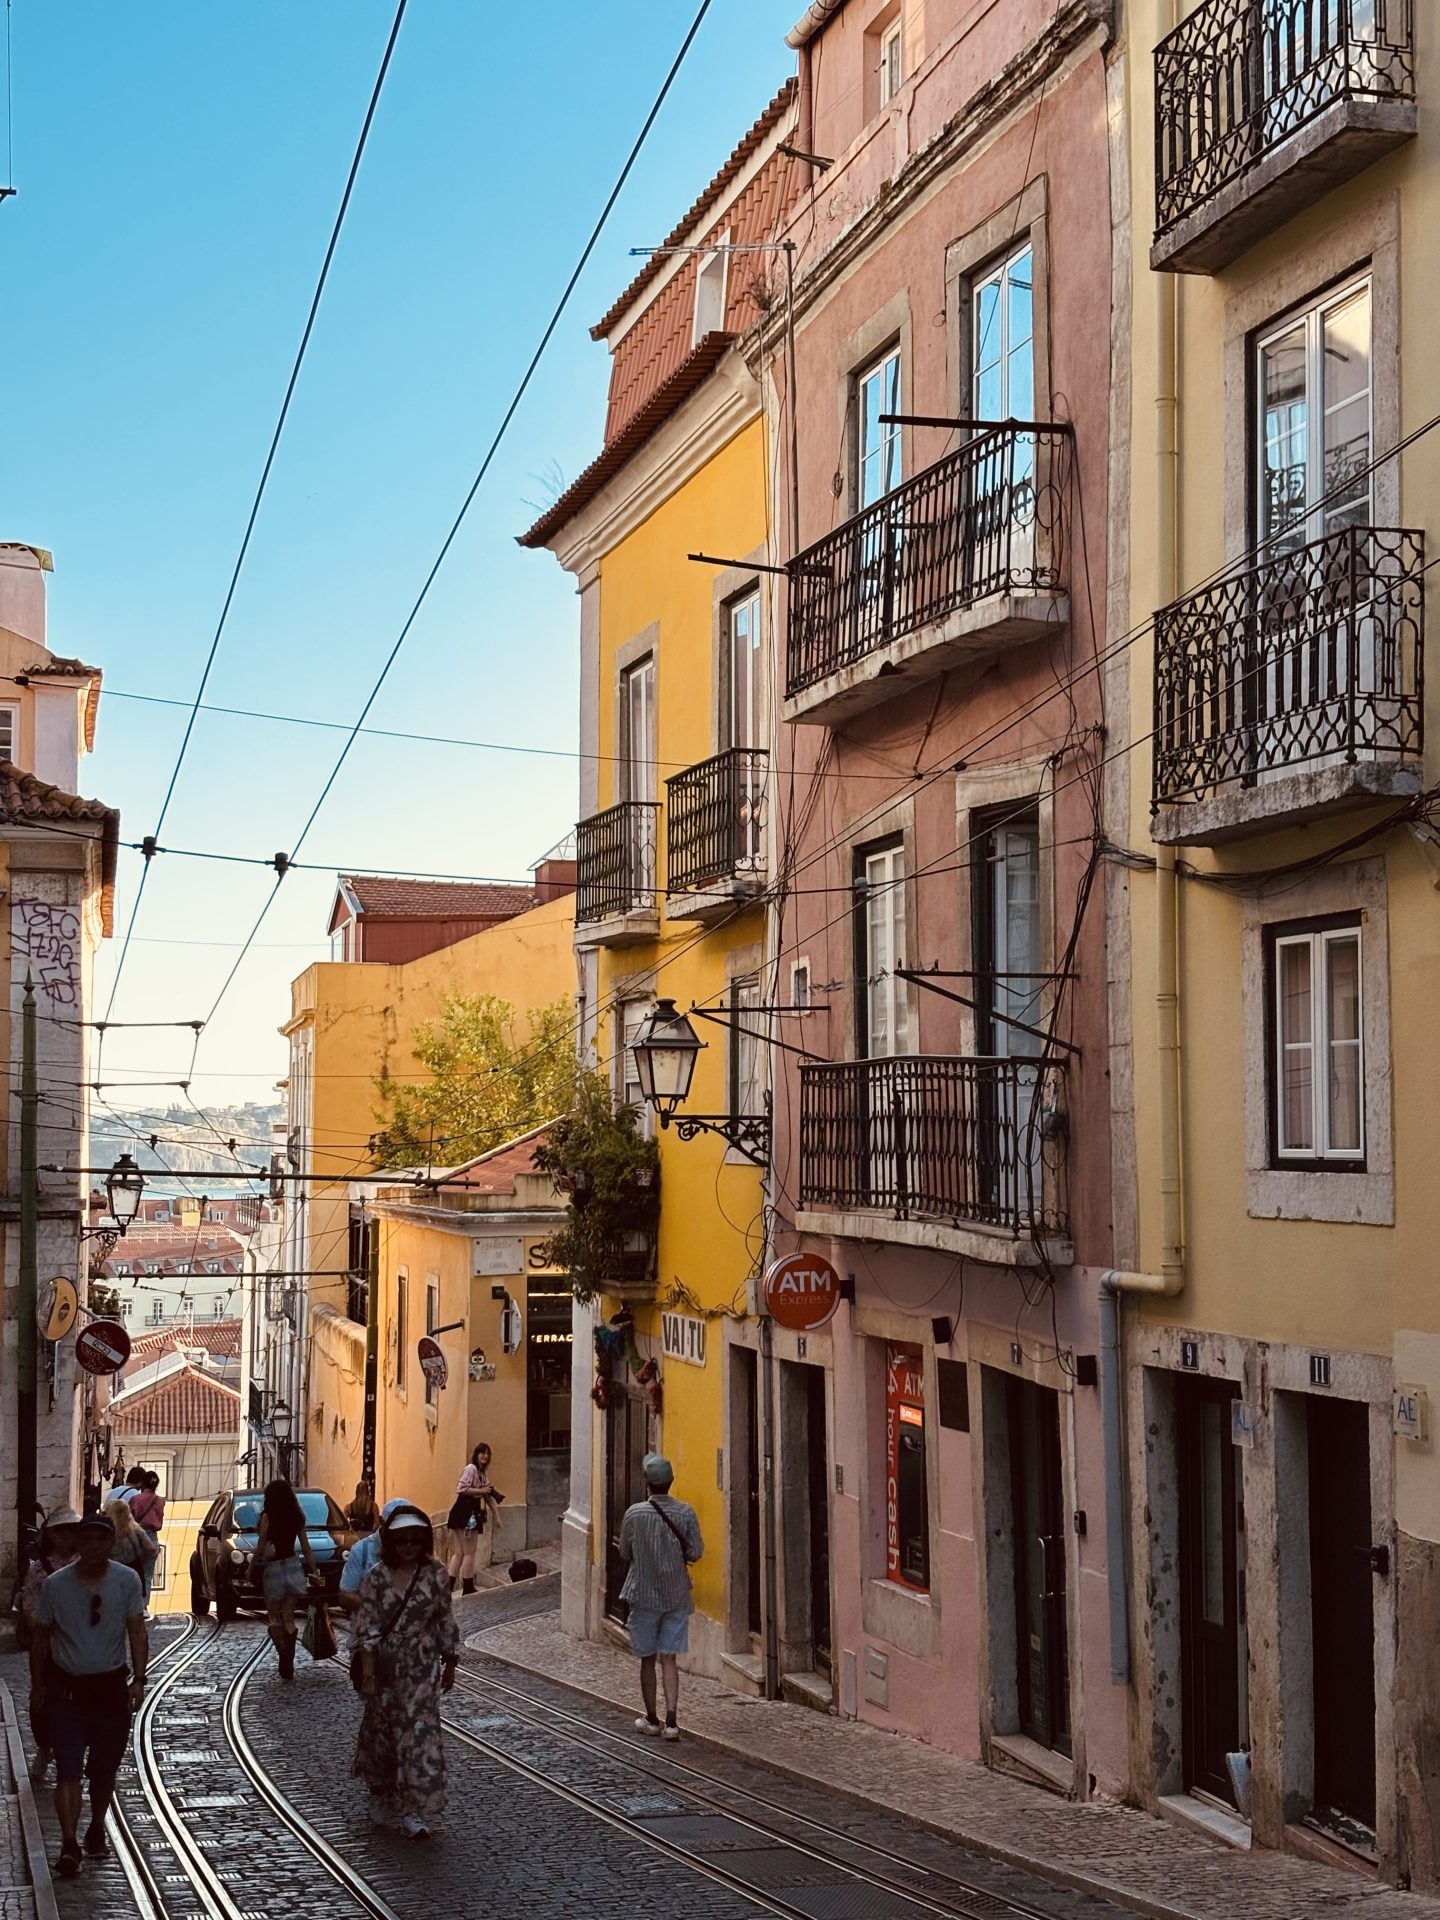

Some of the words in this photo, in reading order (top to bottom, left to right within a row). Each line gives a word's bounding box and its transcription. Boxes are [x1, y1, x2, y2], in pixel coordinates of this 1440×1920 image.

[778, 1271, 831, 1293] ATM
[779, 1293, 830, 1305] Express
[662, 1314, 685, 1355] VAI
[688, 1320, 705, 1361] TU
[1314, 1357, 1326, 1384] 11
[1397, 1395, 1417, 1422] AE
[887, 1408, 896, 1467] hour
[888, 1480, 900, 1570] cash
